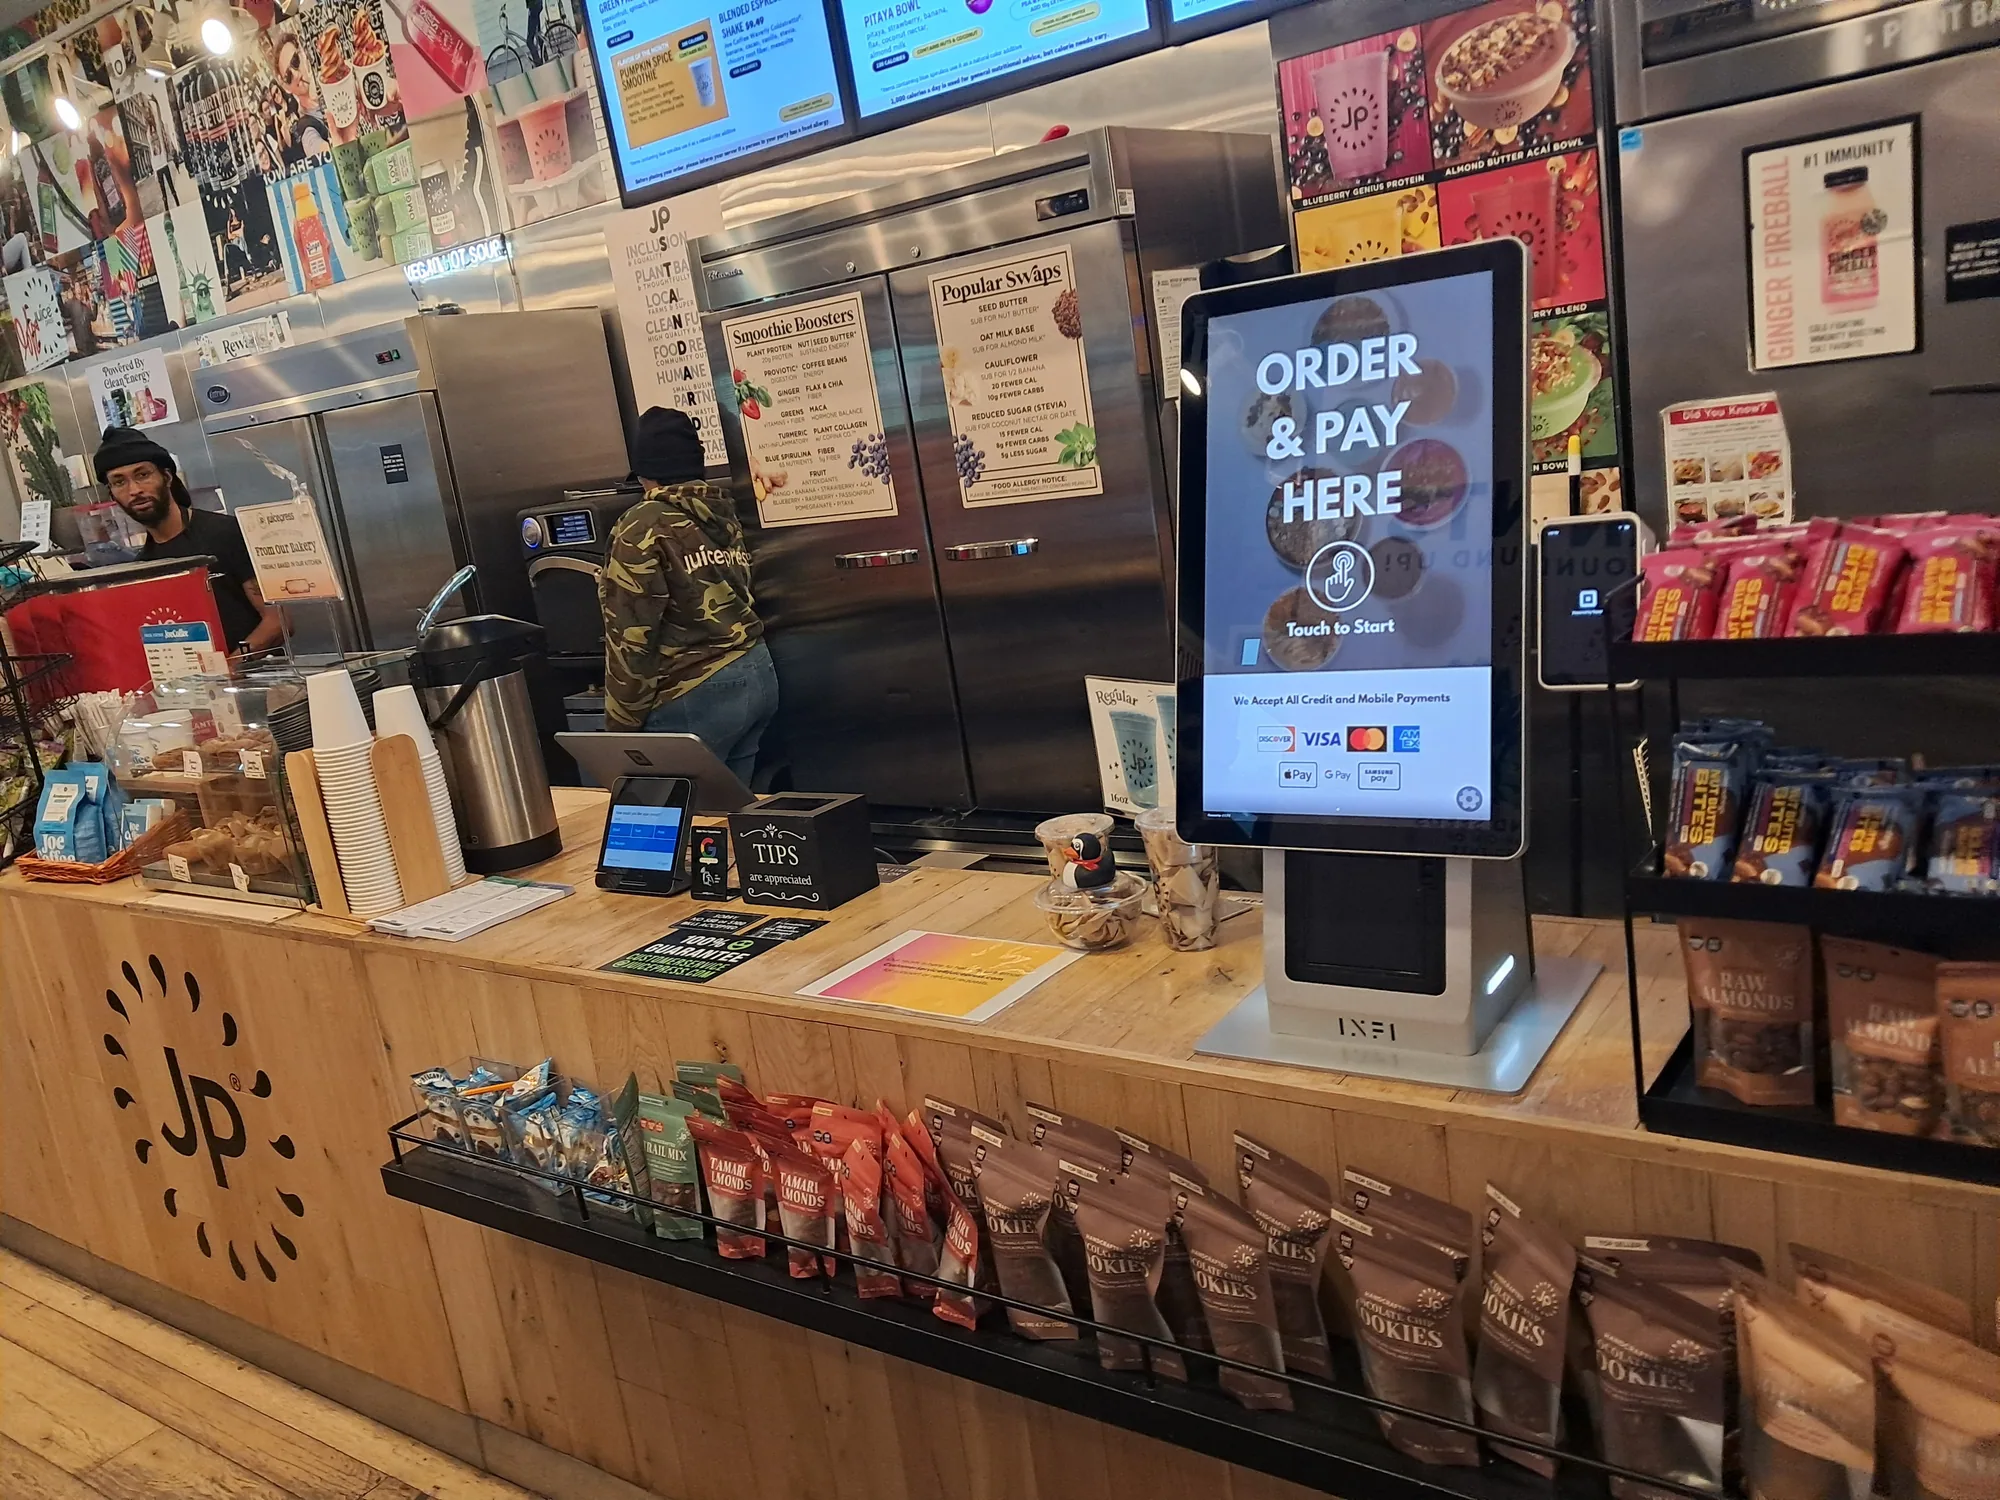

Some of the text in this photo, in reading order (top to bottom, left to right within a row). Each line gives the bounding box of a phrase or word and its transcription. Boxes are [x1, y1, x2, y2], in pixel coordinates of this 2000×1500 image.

[718, 3, 750, 24] BLENDED
[864, 0, 921, 28] PITAYA BOWL
[721, 16, 764, 39] SHAKE $9.49
[881, 31, 906, 45] coconut
[620, 50, 674, 79] PUMPKIN SPICE
[970, 67, 991, 81] general
[991, 58, 1021, 74] nutritional
[1054, 42, 1075, 54] calorie
[1075, 36, 1093, 47] needs
[622, 70, 658, 91] SMOOTHIE
[1341, 106, 1369, 132] JP
[1444, 137, 1585, 177] ALMOND BUTTER BOWL
[1803, 139, 1896, 169] #1 IMMUNITY
[290, 155, 312, 176] ARE
[1302, 174, 1426, 207] BLUEBERRY GENIUS PROTEIN
[649, 206, 671, 234] JP
[626, 230, 688, 259] INCLUSION
[403, 255, 445, 282] VEGAN
[444, 249, 468, 271] HOT
[1761, 155, 1795, 362] GINGER FIREBALL
[635, 261, 671, 283] PLANT
[941, 264, 1062, 304] Popular Swaps
[645, 287, 685, 310] LOCAL
[978, 296, 1028, 313] SEED BUTTER
[648, 303, 668, 316] FARMS
[1554, 302, 1588, 316] BLEND
[645, 314, 682, 335] CLEAN
[732, 308, 854, 346] Smoothie Boosters
[980, 324, 1036, 342] OAT MILK BASE
[661, 328, 690, 341] QUALITY
[653, 340, 688, 360] FOOD
[746, 343, 793, 360] PLANT PROTEIN
[102, 360, 134, 377] Powered
[656, 353, 693, 367] COMMUNITY
[802, 355, 848, 371] COFFEE BEANS
[984, 353, 1039, 370] CAULIFLOWER
[1017, 363, 1046, 375] BANANA
[1256, 333, 1418, 395] ORDER
[103, 368, 152, 390] Clean Energy
[656, 363, 707, 385] HUMANE
[1001, 375, 1038, 388] FEWER CAL
[777, 387, 800, 398] GINGER
[805, 379, 844, 393] FLAX CHIA
[999, 386, 1045, 399] FEWER CARBS
[781, 408, 804, 419] GREENS
[810, 403, 828, 413] MACA
[971, 399, 1067, 422] REDUCED SUGAR (STEVIA)
[1704, 407, 1726, 418] You
[1728, 402, 1768, 416] Know?
[813, 420, 869, 436] PLANT COLLAGEN
[991, 413, 1048, 428] COCONUT NECTAR
[1266, 400, 1412, 460] & PAY
[778, 429, 808, 440] TURMERIC
[1006, 424, 1044, 437] FEWER CAL
[1005, 434, 1050, 448] FEWER CARBS
[765, 449, 812, 464] BLUE SPIRULINA
[817, 446, 836, 456] FIBER
[1009, 446, 1048, 458] LESS SUGAR
[809, 469, 827, 478] FRUIT
[1012, 474, 1067, 488] ALLERGY NOTICE:
[1273, 470, 1403, 524] HERE
[255, 539, 317, 557] From Our Bakery
[1286, 616, 1396, 638] Touch to Start
[1096, 687, 1139, 706] Regular
[1233, 691, 1452, 708] We Accept All Credit and Mobile Payments
[1258, 734, 1292, 744] DISCOVER
[1301, 731, 1342, 747] VISA
[1400, 728, 1421, 740] AM
[1401, 738, 1420, 750] EX
[1130, 753, 1147, 775] JP
[1364, 768, 1394, 776] SAMSUNG
[1292, 769, 1313, 782] Pay
[1708, 768, 1722, 796] NUT
[1110, 792, 1130, 805] 16oz
[1689, 768, 1710, 845] BITES
[1762, 786, 1790, 853] BITES
[41, 834, 65, 854] Joe
[753, 843, 799, 867] TIPS
[749, 872, 812, 887] are appreciated
[680, 934, 728, 948] 100%
[624, 953, 732, 972] CUSTOMERSERVICE
[643, 943, 750, 963] GUARANTEE
[611, 959, 716, 979] @JUICEPRESS.COM
[1719, 972, 1767, 992] RAW
[1702, 985, 1796, 1011] ALMONDS
[1845, 1018, 1931, 1052] ALMOND
[667, 1146, 688, 1162] MIX
[710, 1156, 747, 1178] TAMARI
[779, 1171, 819, 1194] TAMARI
[1612, 1240, 1642, 1249] SELLER
[1191, 1248, 1229, 1270] HANDCRAFTED
[1360, 1307, 1444, 1349] OOKIES
